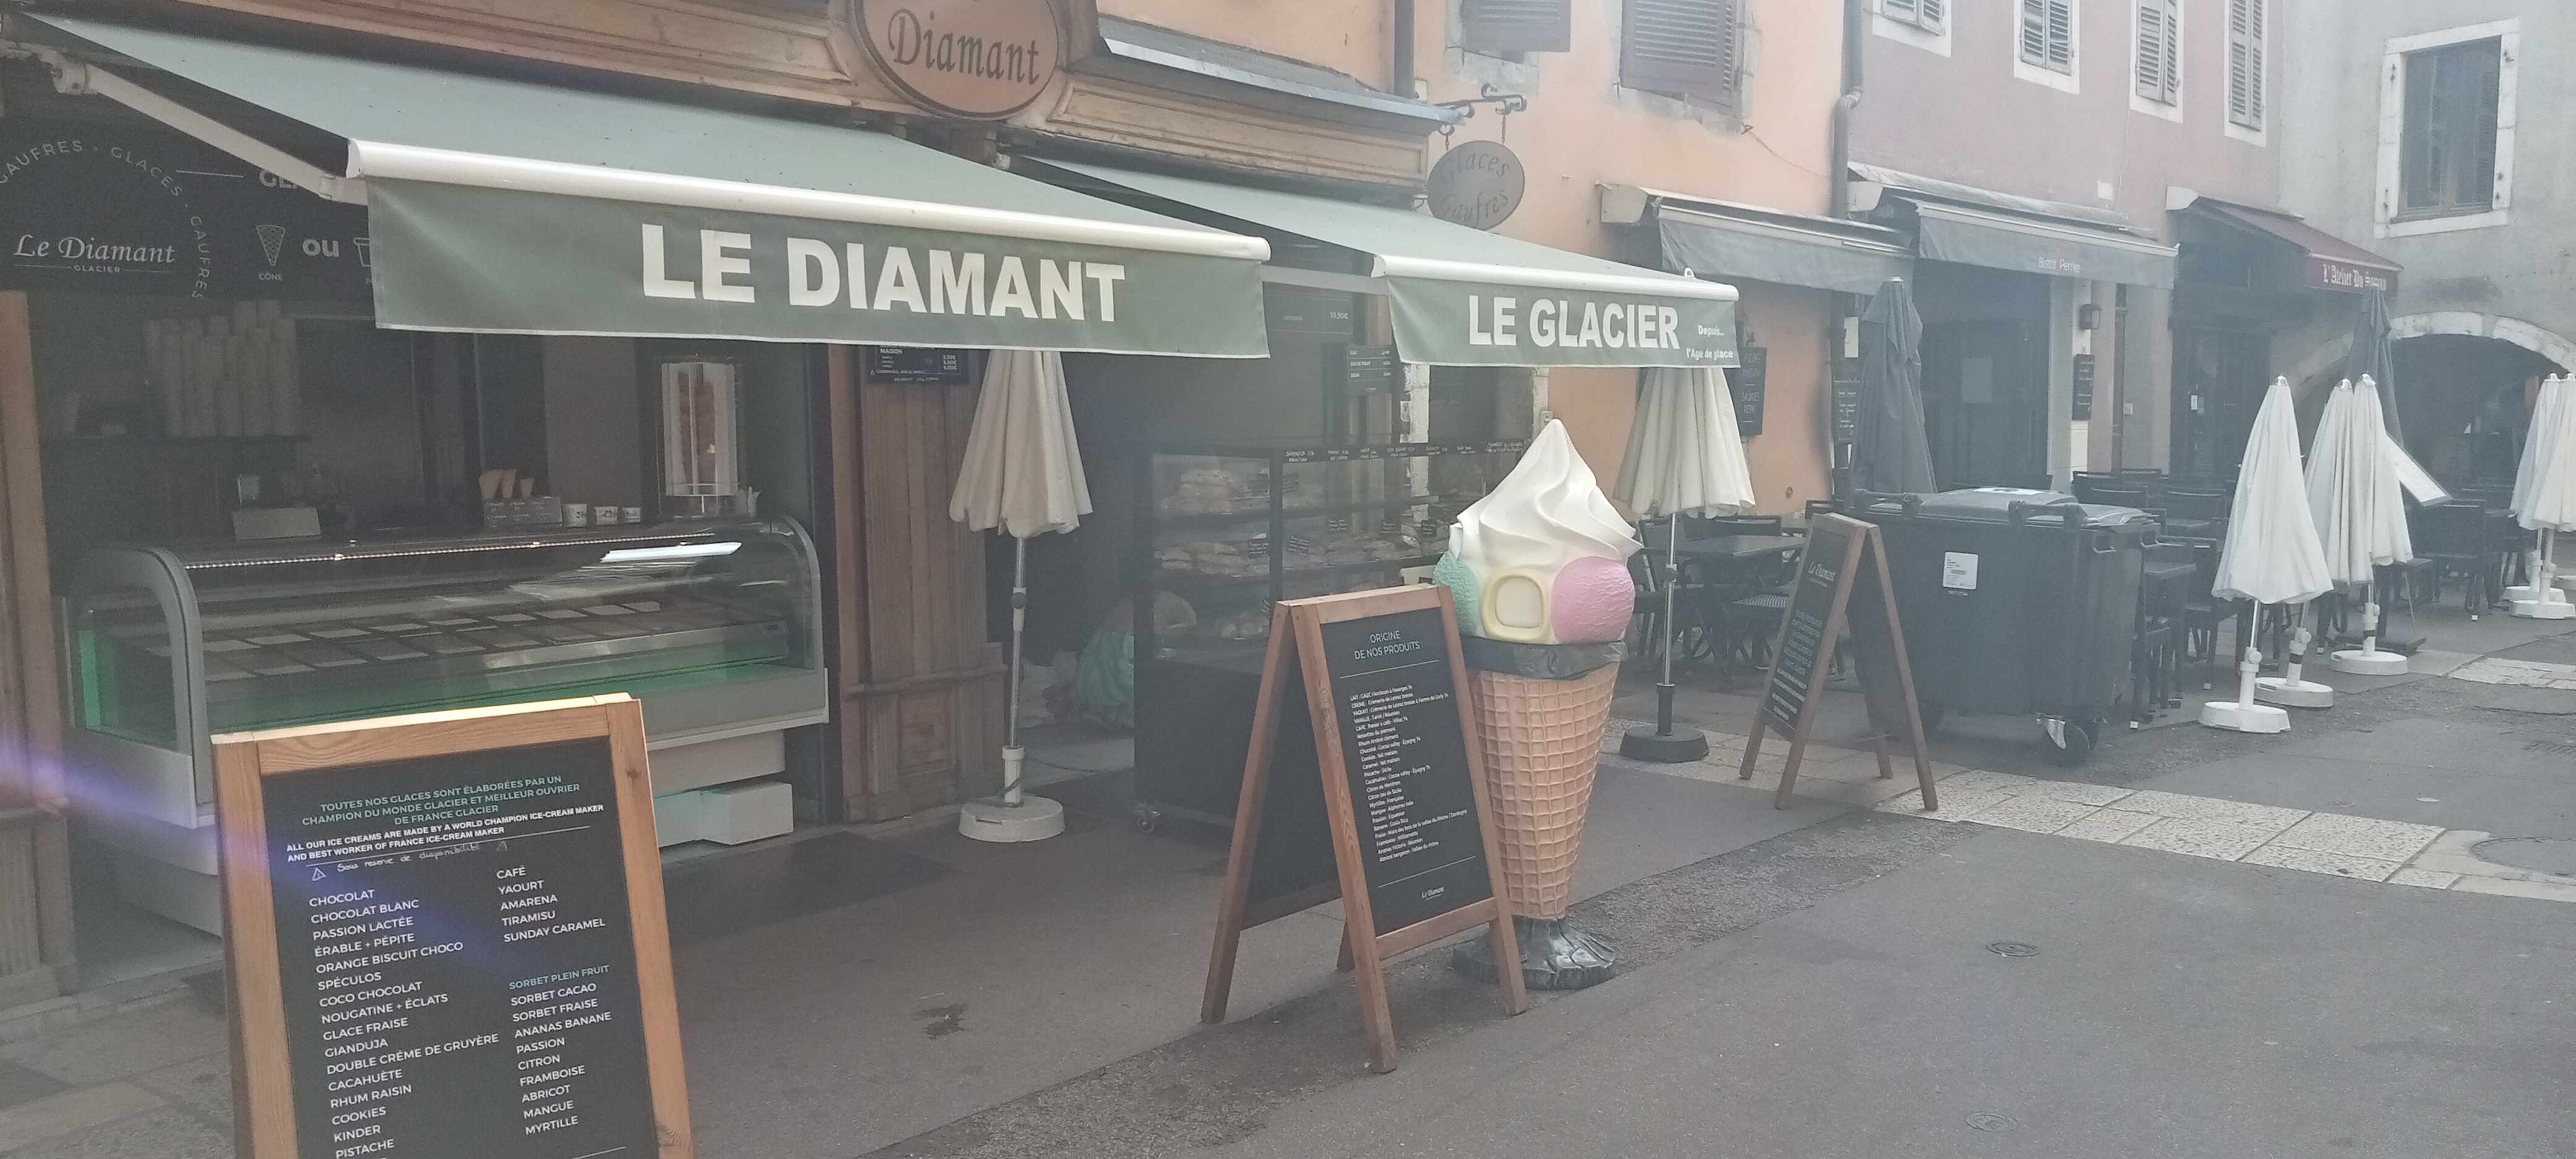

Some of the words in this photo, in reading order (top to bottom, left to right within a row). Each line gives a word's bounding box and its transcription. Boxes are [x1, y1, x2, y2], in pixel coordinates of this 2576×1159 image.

[888, 9, 1039, 85] Diamant
[1440, 147, 1510, 190] Glaces
[1442, 189, 1508, 228] Gaufres
[111, 147, 183, 197] GLACES
[190, 216, 211, 298] GAUFRES
[14, 234, 50, 257] Le
[58, 237, 176, 264] Diamant
[302, 238, 340, 258] ou
[74, 264, 121, 273] GLACIER
[642, 224, 755, 303] LE
[786, 237, 1125, 322] DIAMANT
[1469, 295, 1516, 346] LE
[1530, 298, 1681, 350] GLACIER
[1704, 347, 1713, 358] de
[1713, 348, 1734, 361] glace
[1370, 630, 1401, 643] ORIGINE
[1354, 649, 1366, 660] DE
[1366, 646, 1383, 658] NOS
[1383, 641, 1421, 655] PRODUITS
[302, 811, 362, 825] CHAMPION
[365, 809, 380, 818] DU
[382, 804, 422, 815] MONDE
[424, 797, 468, 809] GLACIER
[471, 796, 483, 805] ET
[485, 789, 534, 802] MEILLEUR
[536, 784, 580, 796] OUVRIER
[321, 800, 363, 812] TOUTES
[365, 797, 388, 805] NOS
[390, 791, 431, 804] GLACES
[433, 788, 461, 797] SONT
[463, 780, 523, 794] ÉLABORÉES
[525, 778, 545, 786] PAR
[547, 776, 562, 784] UN
[394, 816, 410, 825] DE
[411, 811, 453, 823] FRANCE
[455, 805, 499, 817] GLACIER
[286, 843, 304, 852] ALL
[306, 840, 326, 849] OUR
[328, 838, 342, 846] ICE
[344, 833, 381, 844] CREAMS
[384, 830, 402, 839] ARE
[404, 827, 429, 836] MADE
[431, 825, 442, 833] BY
[451, 820, 482, 830] WORLD
[484, 814, 528, 825] CHAMPION
[530, 808, 574, 820] ICE-CREAM
[575, 805, 604, 814] MAKER
[287, 854, 307, 862] AND
[308, 851, 331, 859] BEST
[334, 844, 373, 856] WORKER
[375, 842, 387, 851] OF
[389, 838, 424, 848] FRANCE
[426, 830, 473, 843] ICE-CREAM
[474, 827, 505, 836] MAKER
[336, 862, 359, 872] Sous
[400, 854, 412, 862] de
[308, 889, 375, 907] CHOCOLAT
[498, 880, 544, 895] YAOURT
[311, 905, 377, 924] CHOCOLAT
[380, 899, 420, 914] BLANC
[500, 894, 558, 911] AMARENA
[313, 924, 367, 940] PASSION
[369, 916, 414, 932] LACTÉE
[502, 910, 556, 927] TIRAMISU
[503, 927, 550, 943] SUNDAY
[552, 918, 606, 935] CARAMEL
[315, 940, 363, 958] ÉRABLE
[374, 932, 415, 948] PÉPITE
[316, 957, 370, 974] ORANGE
[372, 948, 419, 965] BISCUIT
[420, 941, 464, 957] CHOCO
[318, 971, 382, 991] SPÉCULOS
[509, 976, 549, 990] SORBET
[551, 970, 580, 983] PLEIN
[581, 965, 610, 978] FRUIT
[319, 993, 355, 1007] COCO
[357, 981, 423, 1001] CHOCOLAT
[511, 990, 555, 1006] SORBET
[557, 983, 597, 997] CACAO
[321, 1002, 394, 1023] NOUGATINE
[405, 993, 448, 1010] ÉCLATS
[513, 1006, 557, 1022] SORBET
[560, 998, 598, 1014] FRAISE
[323, 1025, 363, 1041] GLACE
[366, 1017, 409, 1033] FRAISE
[515, 1021, 562, 1039] ANANAS
[565, 1012, 612, 1029] BANANE
[324, 1038, 389, 1057] GIANDUJA
[326, 1057, 377, 1075] DOUBLE
[425, 1044, 442, 1056] DE
[443, 1033, 500, 1052] GRUYÈRE
[516, 1037, 565, 1054] PASSION
[518, 1054, 560, 1070] CITRON
[328, 1069, 403, 1092] CACAHUÈTE
[520, 1065, 586, 1087] FRAMBOISE
[330, 1093, 368, 1109] RHUM
[372, 1084, 412, 1101] RAISIN
[521, 1084, 571, 1103] ABRICOT
[331, 1106, 387, 1126] COOKIES
[523, 1100, 574, 1119] MANGUE
[334, 1124, 381, 1143] KINDER
[525, 1115, 579, 1135] MYRTILLE
[336, 1138, 395, 1159] PISTACHE
